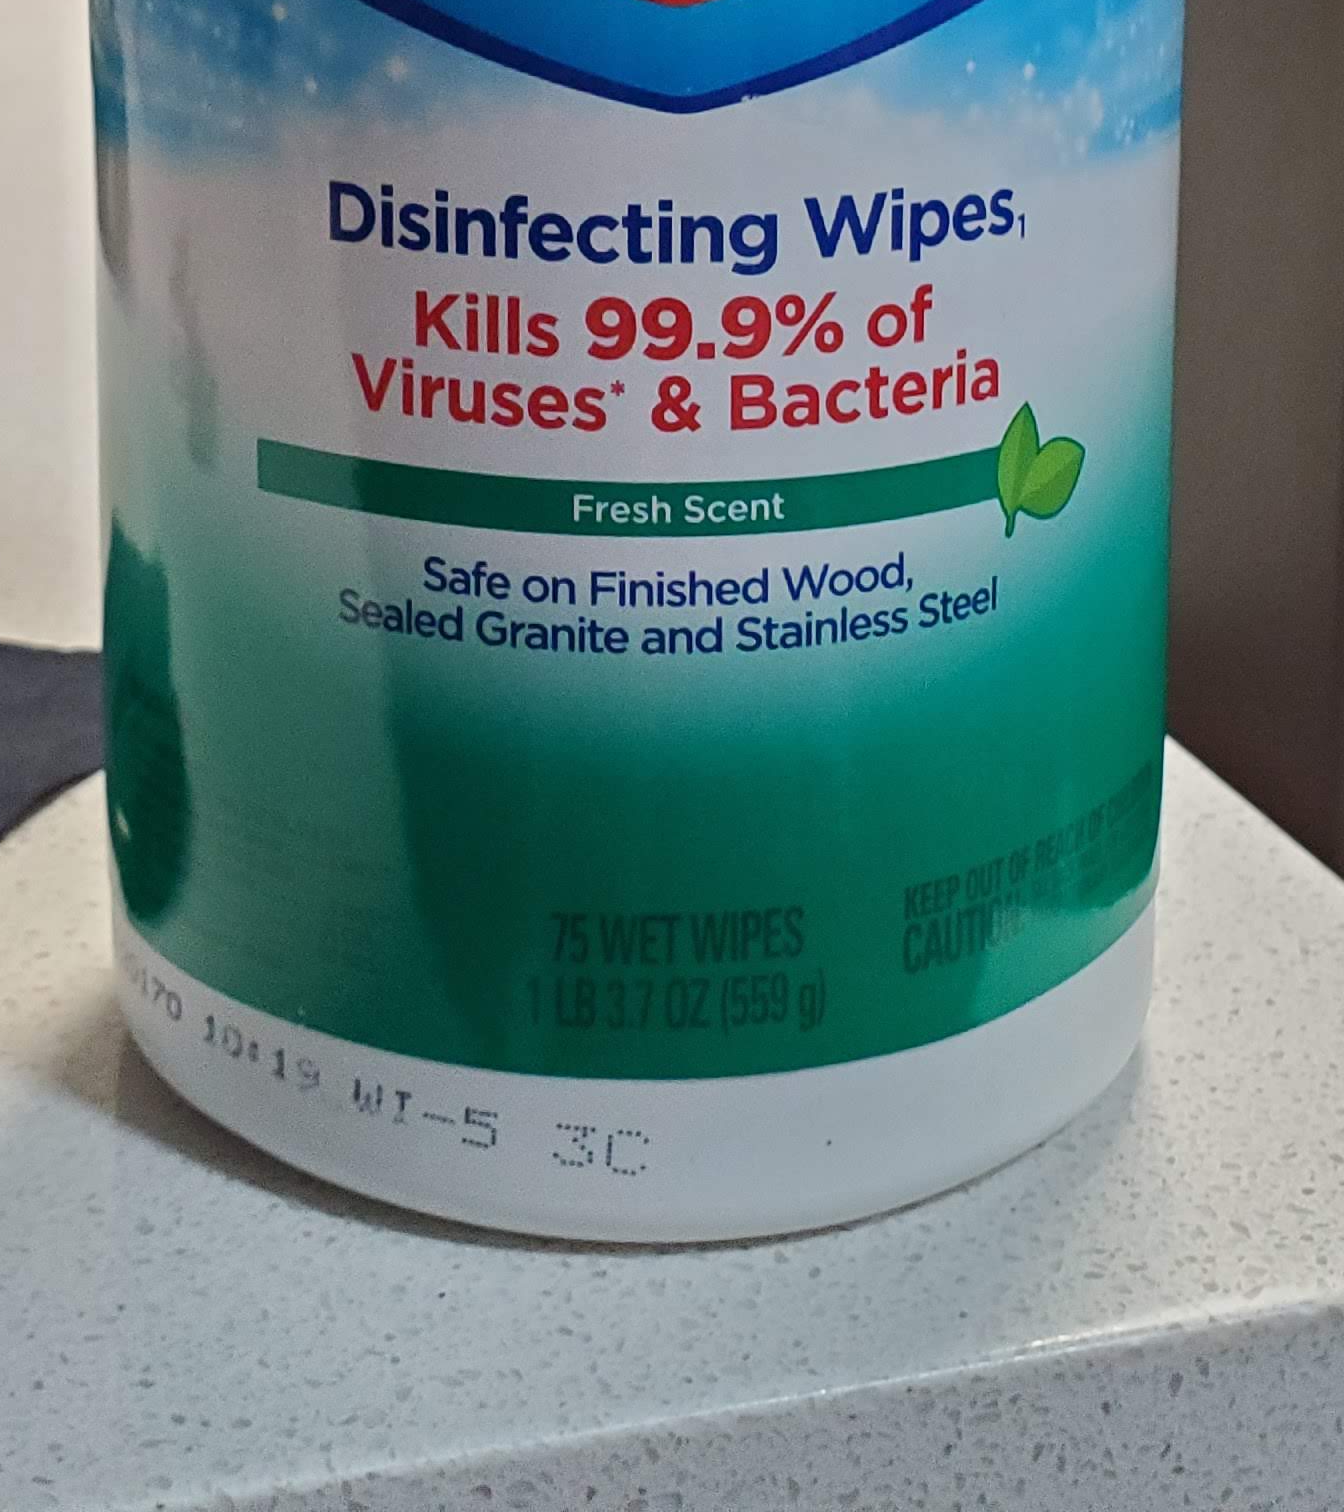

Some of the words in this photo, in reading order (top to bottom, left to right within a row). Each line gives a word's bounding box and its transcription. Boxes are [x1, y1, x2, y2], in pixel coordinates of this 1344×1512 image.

[329, 180, 778, 276] Disinfecting
[415, 290, 560, 358] Kills
[585, 291, 844, 361] 99.9%
[867, 284, 933, 348] of
[651, 375, 702, 433] &
[730, 348, 999, 431] Bacteria
[573, 493, 671, 524] Fresh
[684, 493, 785, 524] Scent
[423, 556, 511, 600] Safe
[522, 574, 576, 606] on
[590, 567, 769, 607] Finished
[782, 551, 913, 601] Wood,
[339, 588, 463, 642] Sealed
[475, 610, 629, 654] Granite
[641, 616, 723, 655] and
[736, 606, 909, 652] Stainless
[918, 575, 998, 628] Steel
[904, 873, 960, 921] KEEP
[966, 856, 1004, 901] OUT
[550, 912, 588, 964] 75
[599, 913, 681, 966] WET
[691, 905, 805, 964] WIPES
[554, 976, 596, 1029] LB
[665, 977, 711, 1029] OZ
[553, 1123, 649, 1176] 3C
